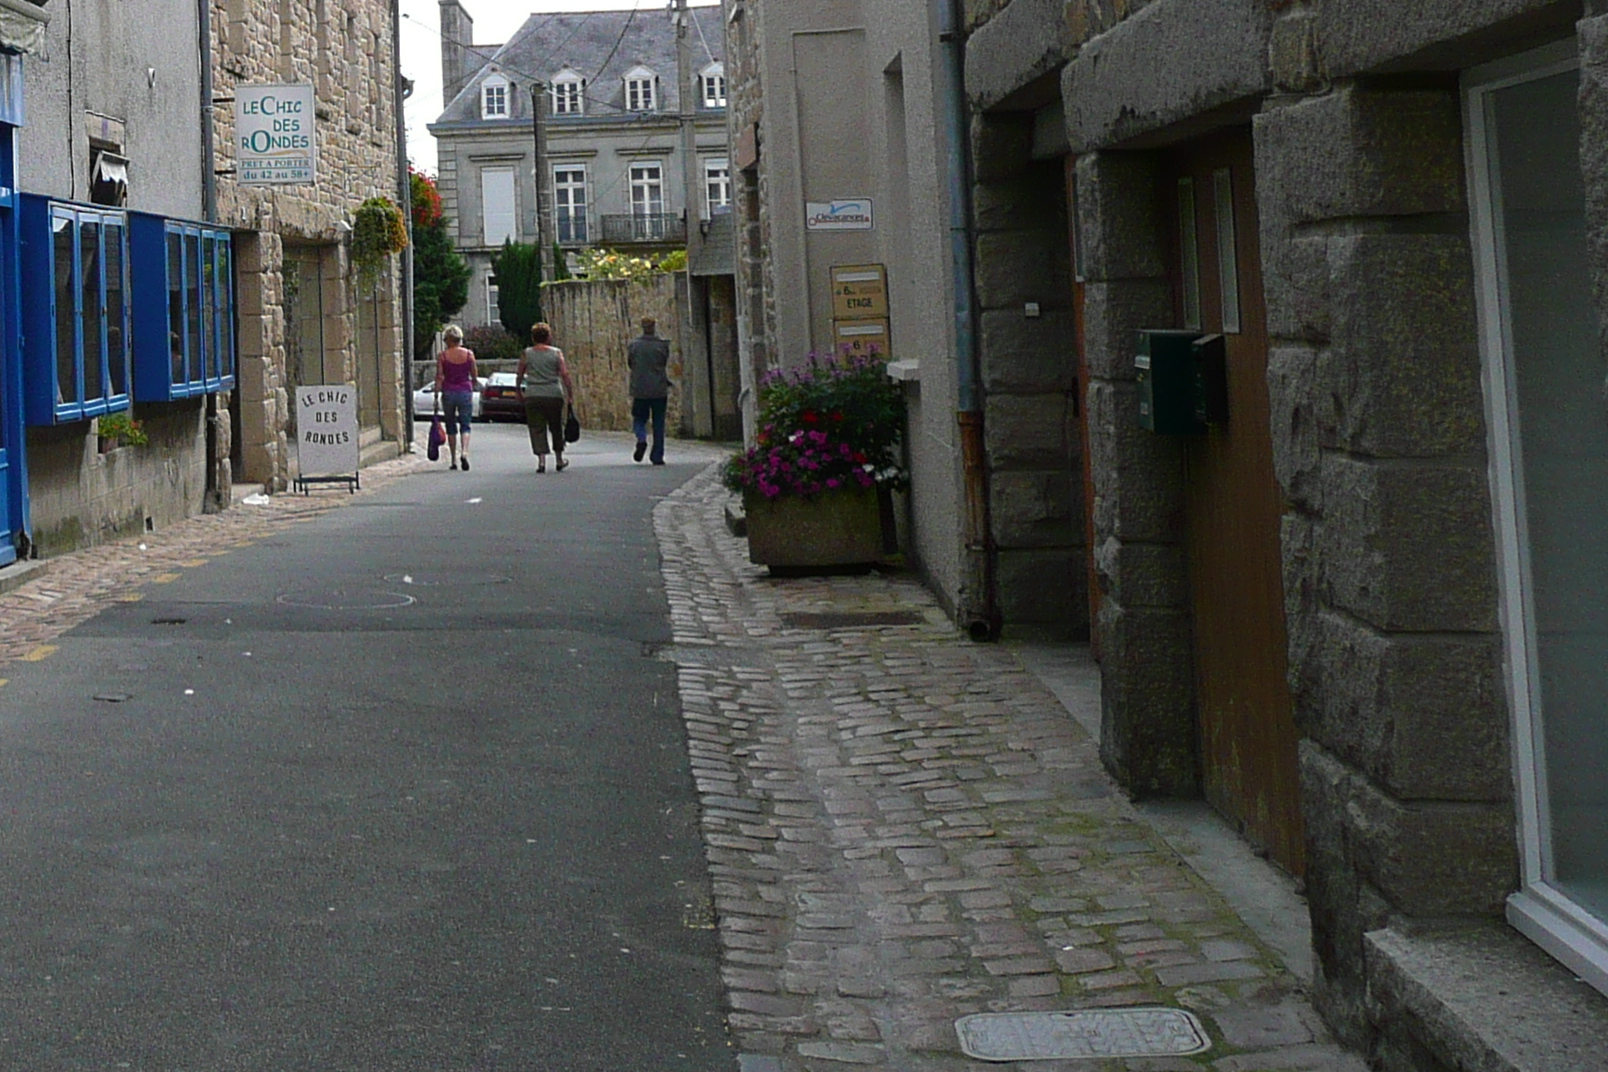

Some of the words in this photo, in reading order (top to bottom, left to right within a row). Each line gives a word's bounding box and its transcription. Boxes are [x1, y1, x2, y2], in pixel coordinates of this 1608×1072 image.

[243, 101, 259, 115] LE
[273, 118, 300, 132] DES
[241, 130, 309, 153] RONDES
[274, 159, 310, 167] PORTER
[243, 170, 257, 179] du
[260, 170, 272, 179] 42
[301, 394, 315, 408] LE
[318, 391, 348, 404] CHIC
[315, 411, 337, 423] DES
[305, 431, 349, 445] RONDES
